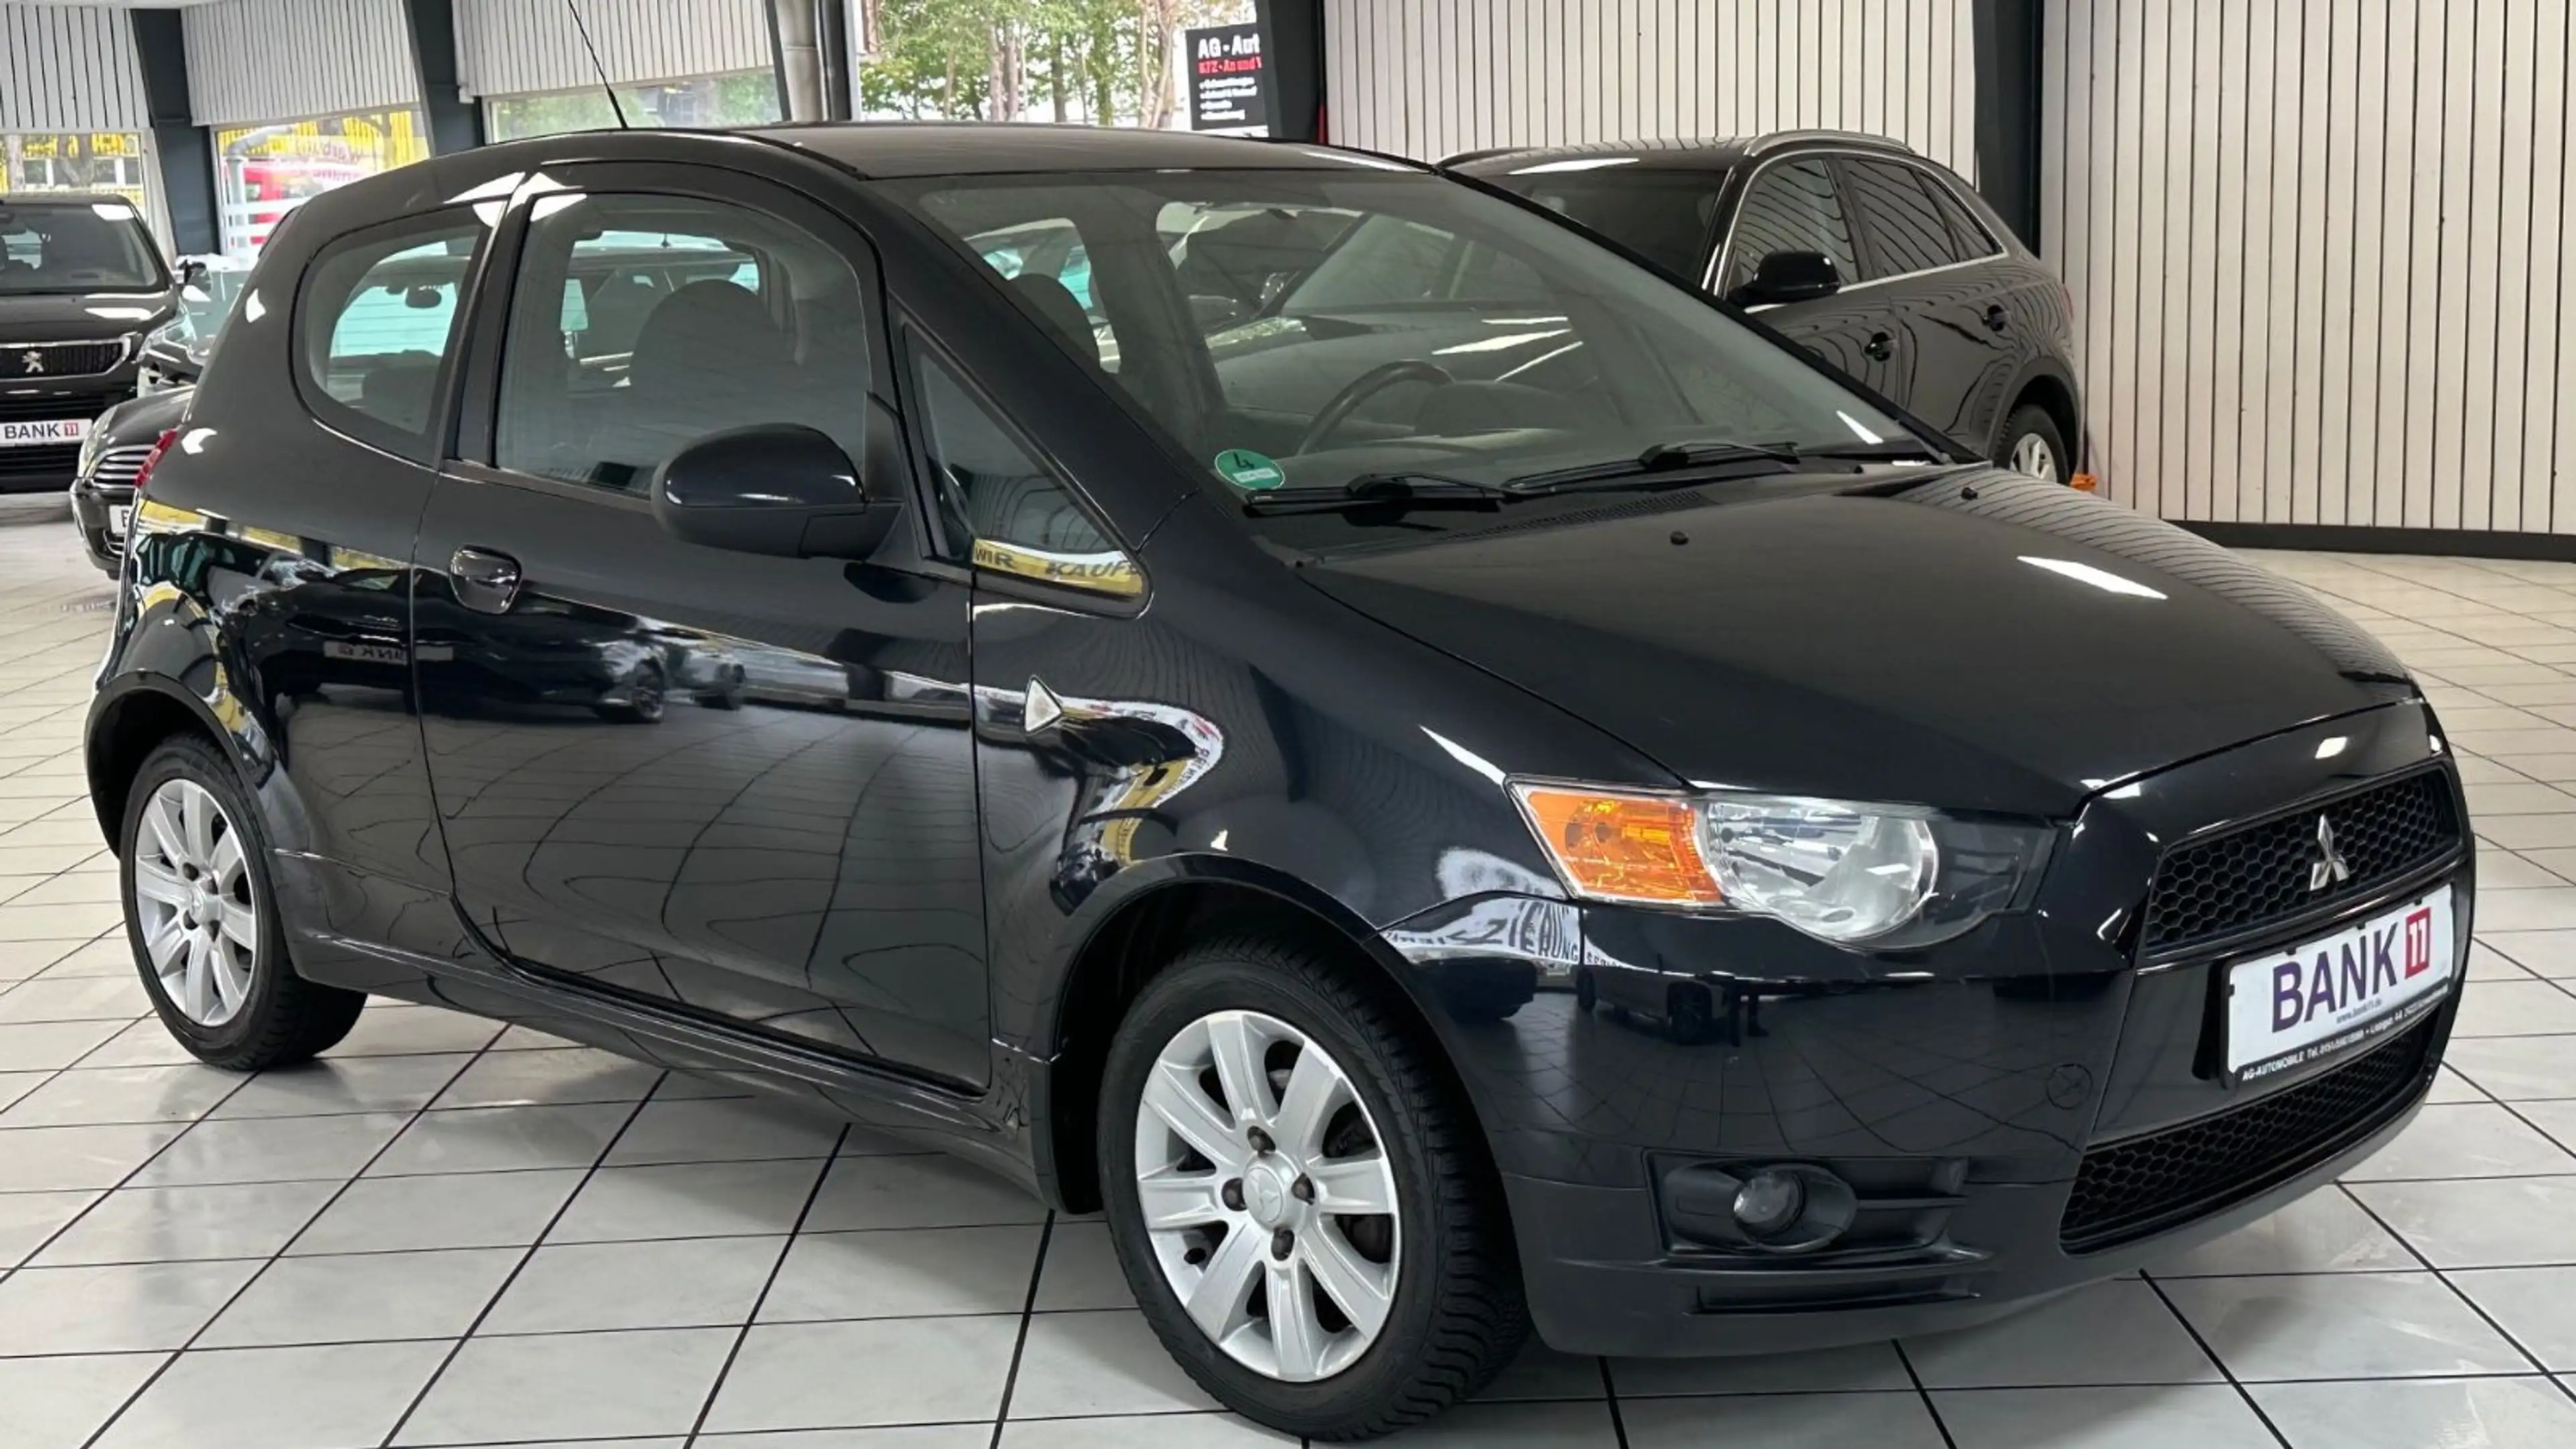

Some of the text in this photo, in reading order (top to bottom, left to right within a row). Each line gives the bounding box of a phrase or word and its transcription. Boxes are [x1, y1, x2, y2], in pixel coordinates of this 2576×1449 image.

[4, 423, 60, 439] BANK
[1234, 452, 1254, 469] 4
[2271, 914, 2429, 1033] BANK 11
